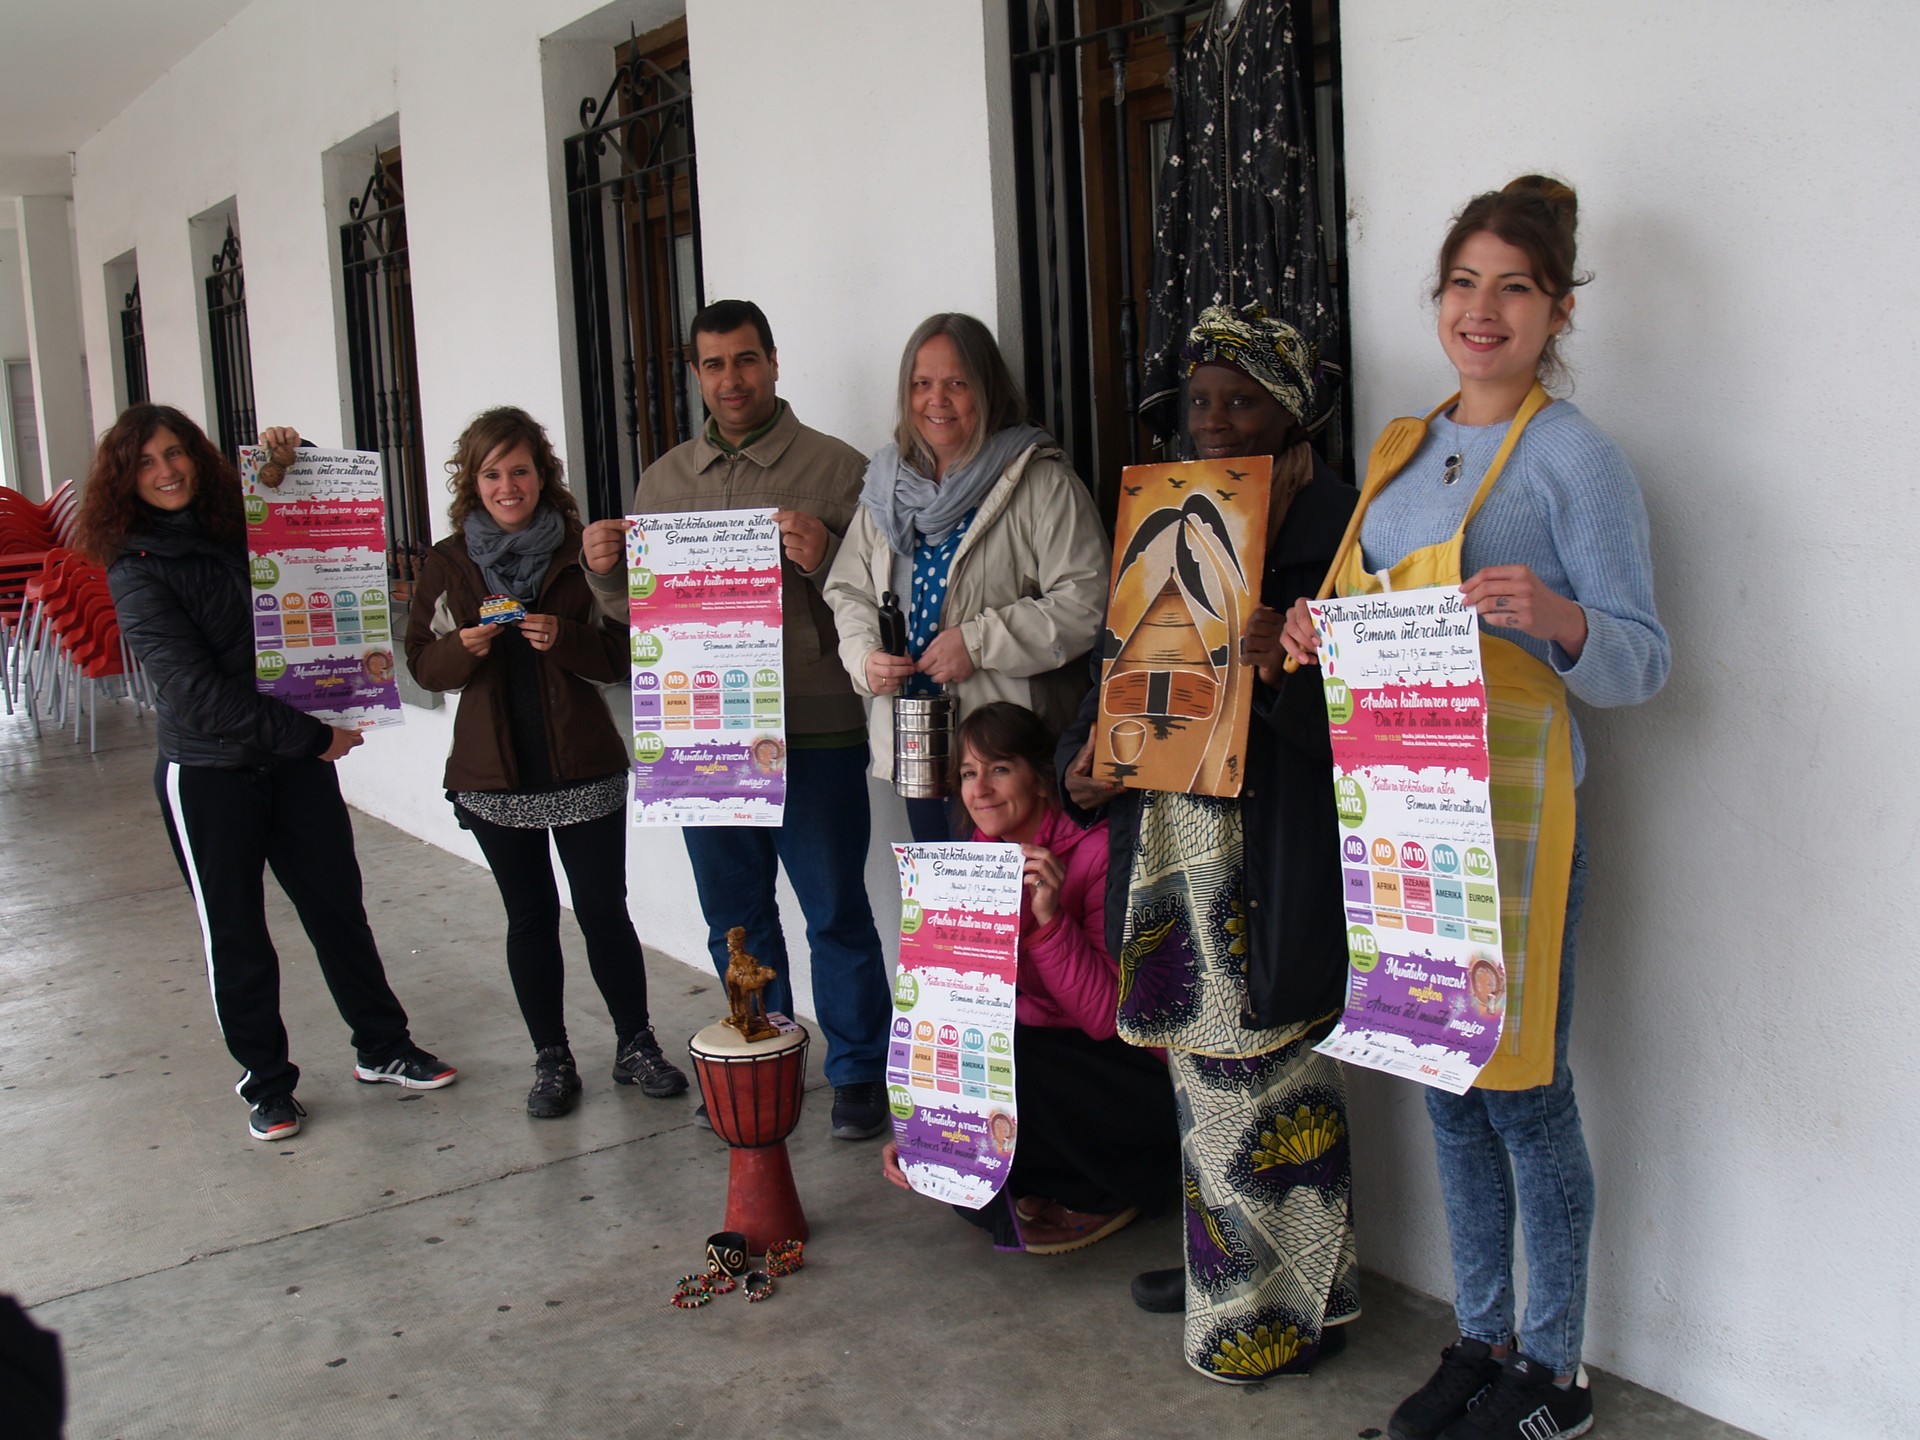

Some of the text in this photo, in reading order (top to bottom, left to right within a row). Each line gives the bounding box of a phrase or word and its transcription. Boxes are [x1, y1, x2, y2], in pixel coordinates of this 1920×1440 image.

[352, 455, 376, 465] astea
[318, 464, 378, 476] intercultural
[246, 501, 263, 512] M7
[636, 514, 772, 532] Kulturartekotasunaren astea
[666, 527, 776, 545] Semana intercultural
[254, 560, 269, 568] M8
[630, 573, 650, 586] M7
[664, 576, 776, 588] Arabiar kulturaren eguna
[259, 598, 274, 606] M8
[286, 596, 300, 605] M9
[1320, 595, 1468, 624] Kulturartekotasunaren astea
[1354, 615, 1472, 644] Semana intercultural
[636, 636, 652, 646] M8
[704, 639, 779, 650] Semana intercultural
[257, 656, 283, 668] M13
[292, 665, 331, 679] Munduko
[756, 672, 776, 682] M12
[639, 676, 654, 686] M8
[668, 675, 684, 684] M9
[696, 674, 716, 684] M10
[726, 674, 745, 683] M11
[1326, 686, 1346, 704] M7
[1360, 691, 1479, 712] Arabiar kulturaren eguna
[1421, 712, 1450, 727] cultura
[635, 738, 661, 750] M13
[670, 749, 749, 764] Munduko arrozak
[1339, 780, 1355, 796] M8
[1437, 782, 1455, 794] astea
[1406, 795, 1486, 814] Semana intercultural
[904, 846, 1018, 863] Kulturartekotasunaren astea
[1347, 841, 1362, 856] M8
[1376, 844, 1391, 858] M9
[1404, 845, 1424, 861] M10
[1434, 849, 1455, 865] M11
[1466, 851, 1489, 869] M12
[933, 861, 1020, 880] Semana intercultural
[1351, 878, 1364, 887] ASIA
[1377, 882, 1397, 891] AFRIKA
[1404, 878, 1430, 888] OZEANIA
[1436, 889, 1462, 900] AMERIKA
[1468, 894, 1494, 904] EUROPA
[903, 905, 919, 919] M7
[1349, 932, 1376, 954] M13
[1385, 957, 1466, 989] Munduko arrozak
[900, 976, 912, 986] M8
[896, 1021, 909, 1032] M8
[918, 1024, 930, 1036] M9
[940, 1028, 957, 1040] M10
[964, 1032, 980, 1044] M11
[990, 1036, 1008, 1048] M12
[962, 1061, 984, 1070] AMERIKA
[990, 1065, 1010, 1074] EUROPA
[889, 1090, 912, 1106] M13
